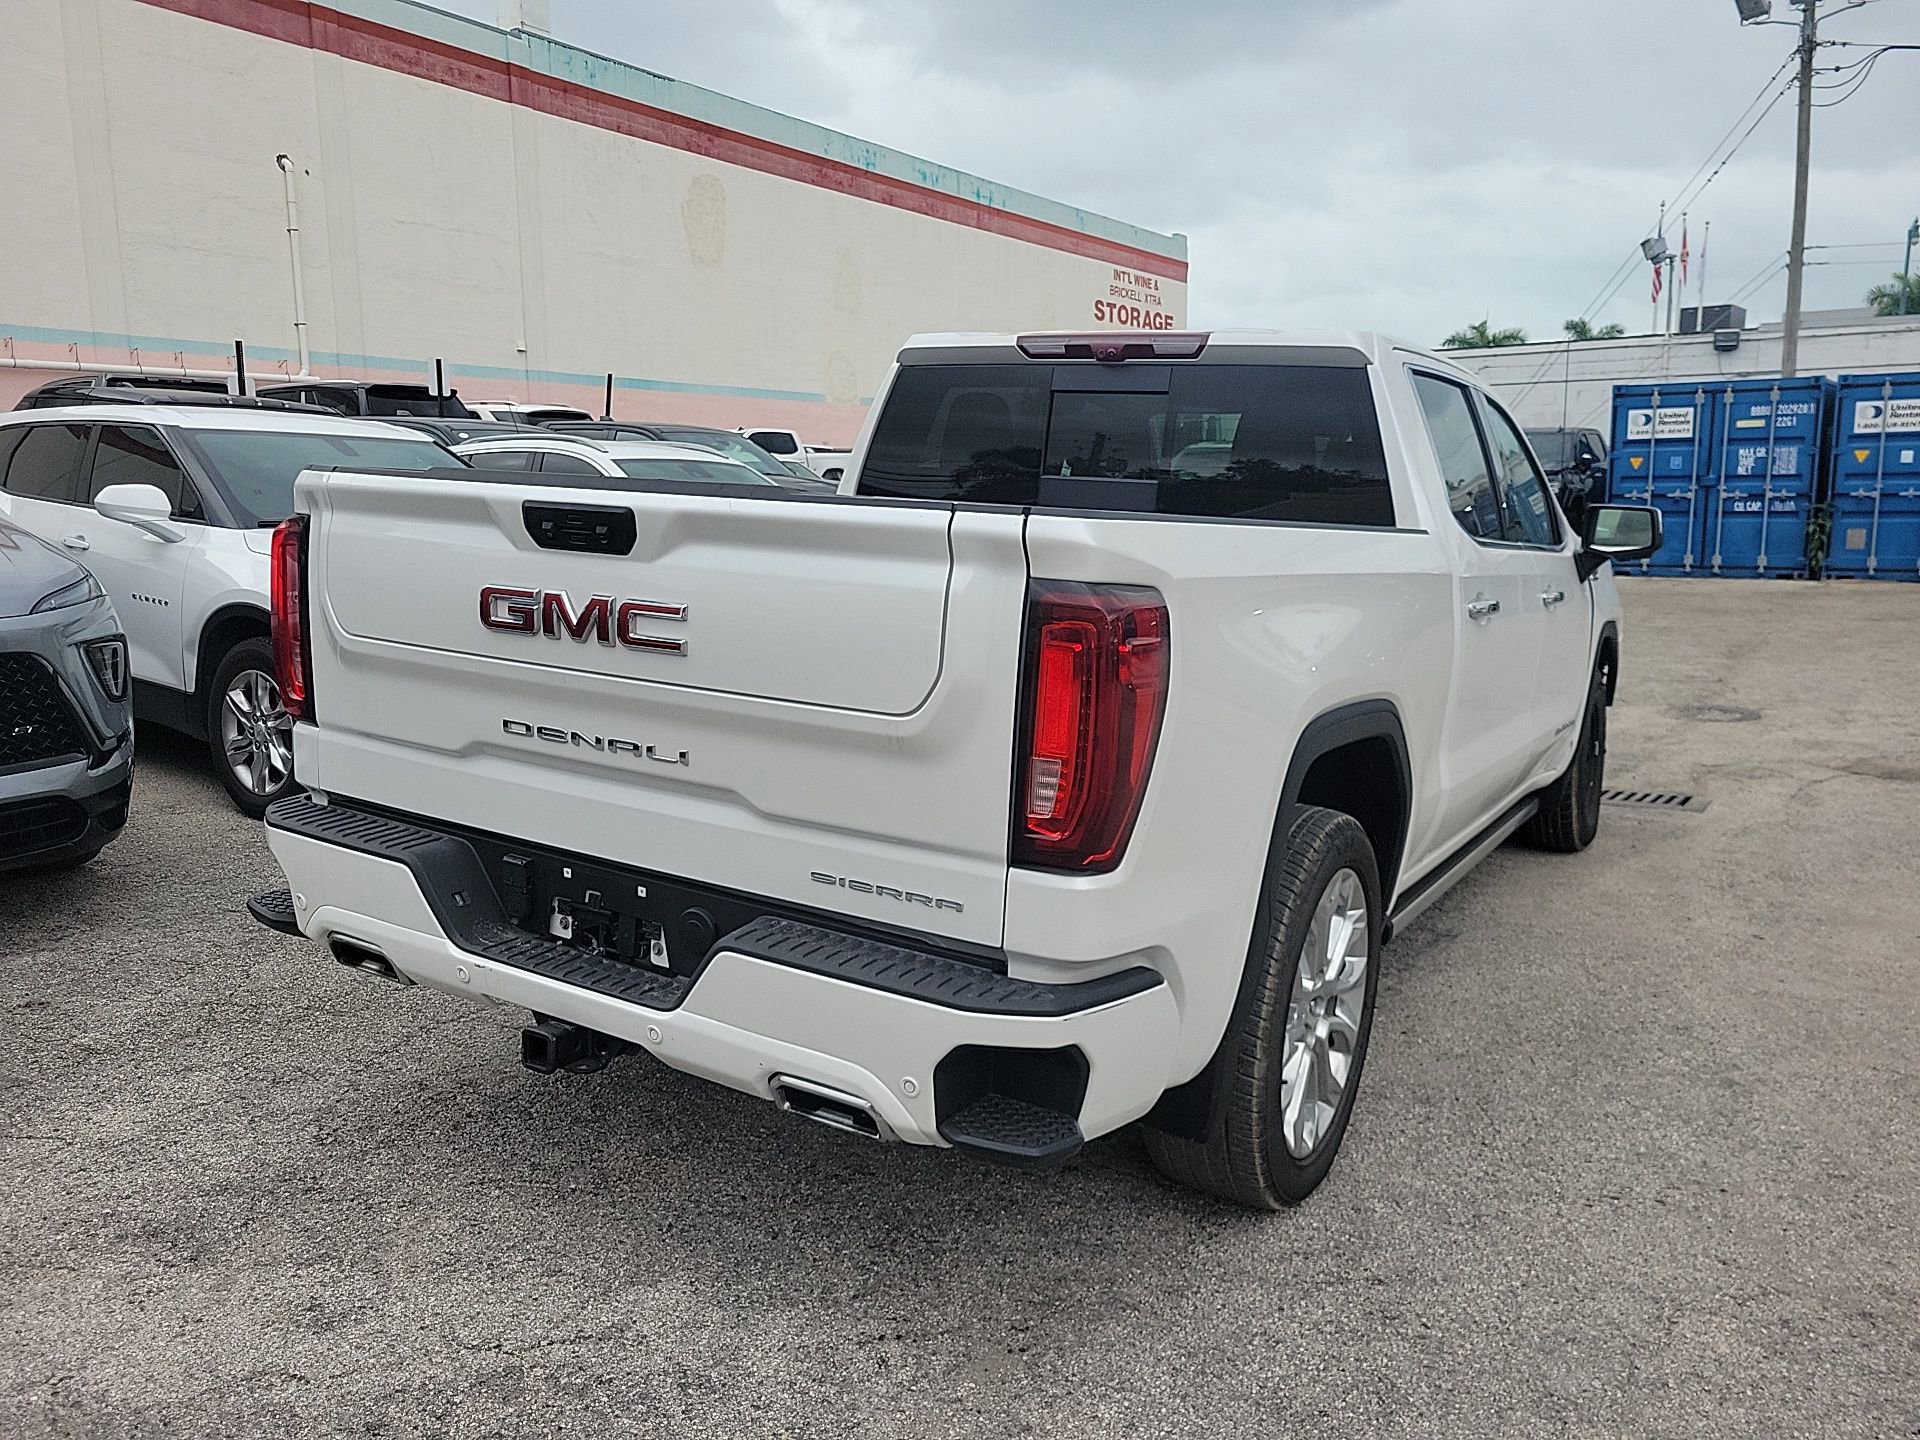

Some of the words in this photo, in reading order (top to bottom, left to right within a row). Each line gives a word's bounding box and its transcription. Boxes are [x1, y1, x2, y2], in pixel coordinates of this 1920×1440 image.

[1134, 274, 1152, 290] WINE
[1154, 280, 1159, 291] &
[1109, 285, 1142, 302] BRICKELL
[1145, 293, 1162, 306] XTRA
[1094, 299, 1174, 330] STORAGE
[1658, 411, 1689, 419] United
[1658, 419, 1690, 427] Rentals
[131, 592, 169, 607] BLAZER
[479, 584, 689, 656] GMC
[502, 718, 690, 767] DENALI
[810, 870, 965, 913] SIERRA
